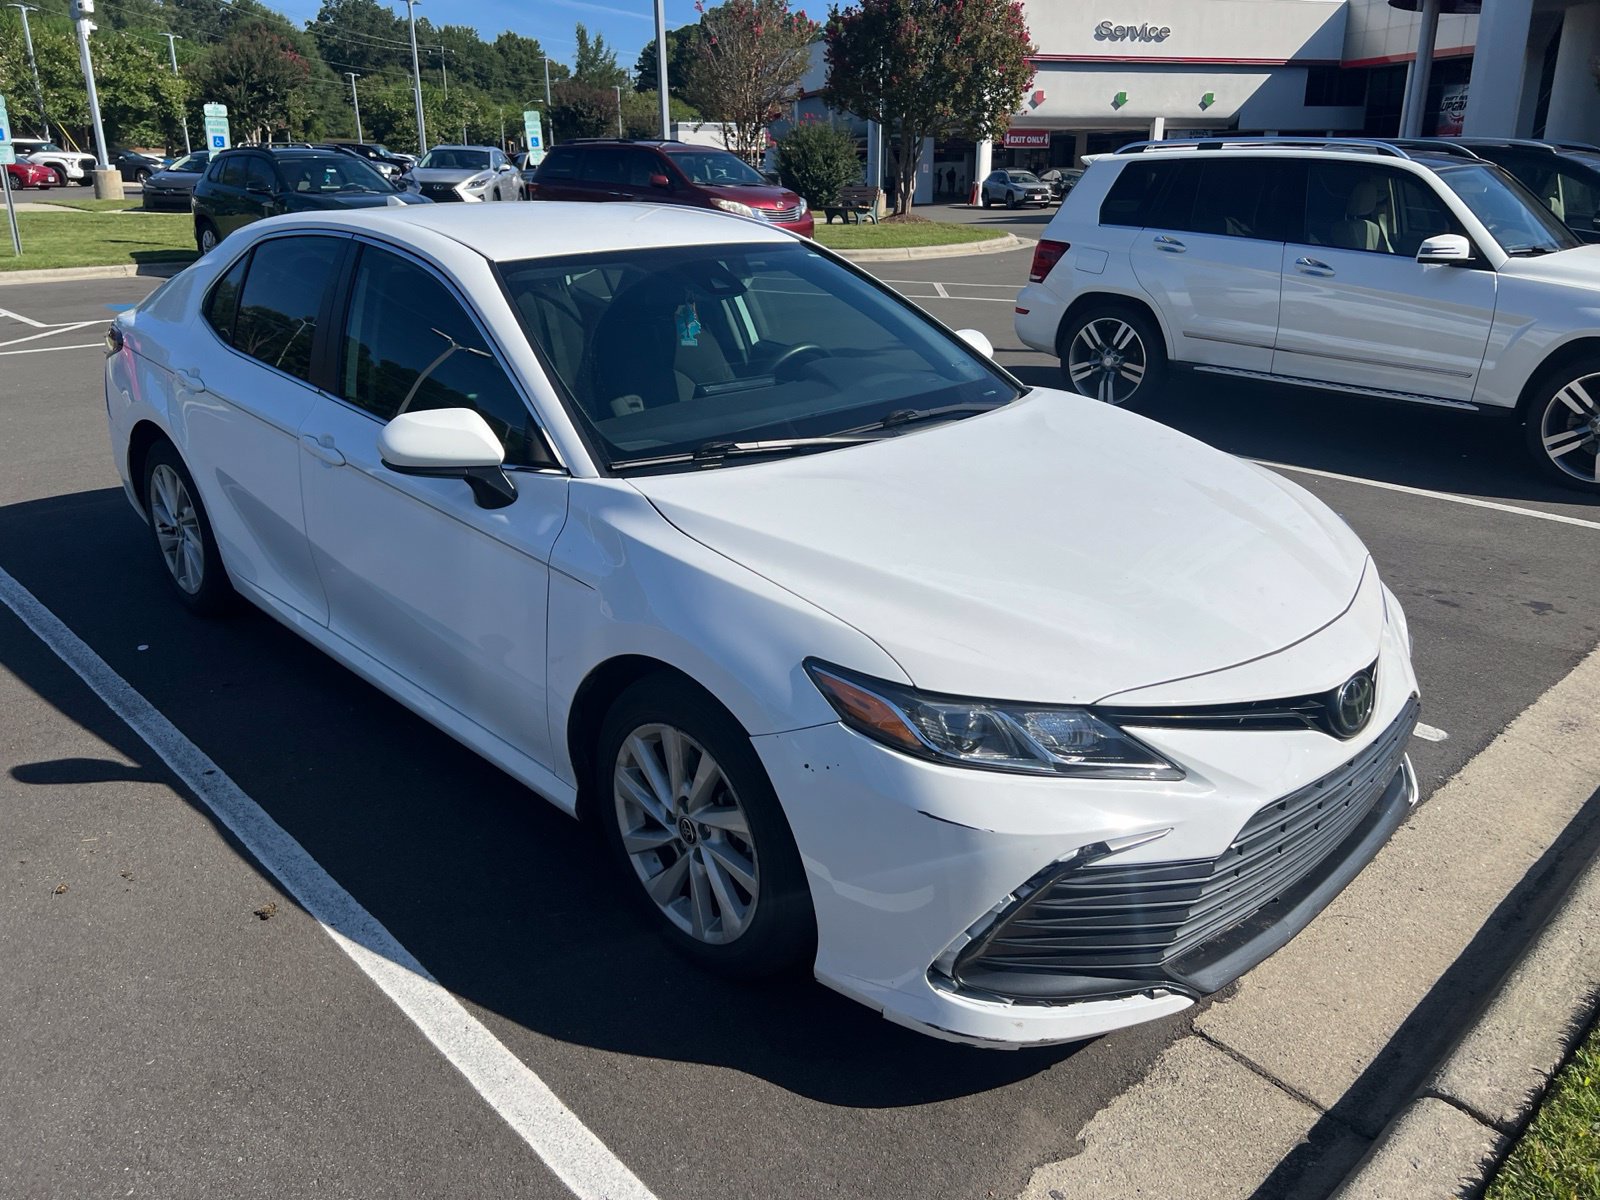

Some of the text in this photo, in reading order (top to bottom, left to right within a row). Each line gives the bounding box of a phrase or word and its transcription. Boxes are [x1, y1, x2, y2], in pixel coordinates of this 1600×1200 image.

[1098, 20, 1171, 39] Service
[1010, 135, 1045, 144] EXIT ONLY
